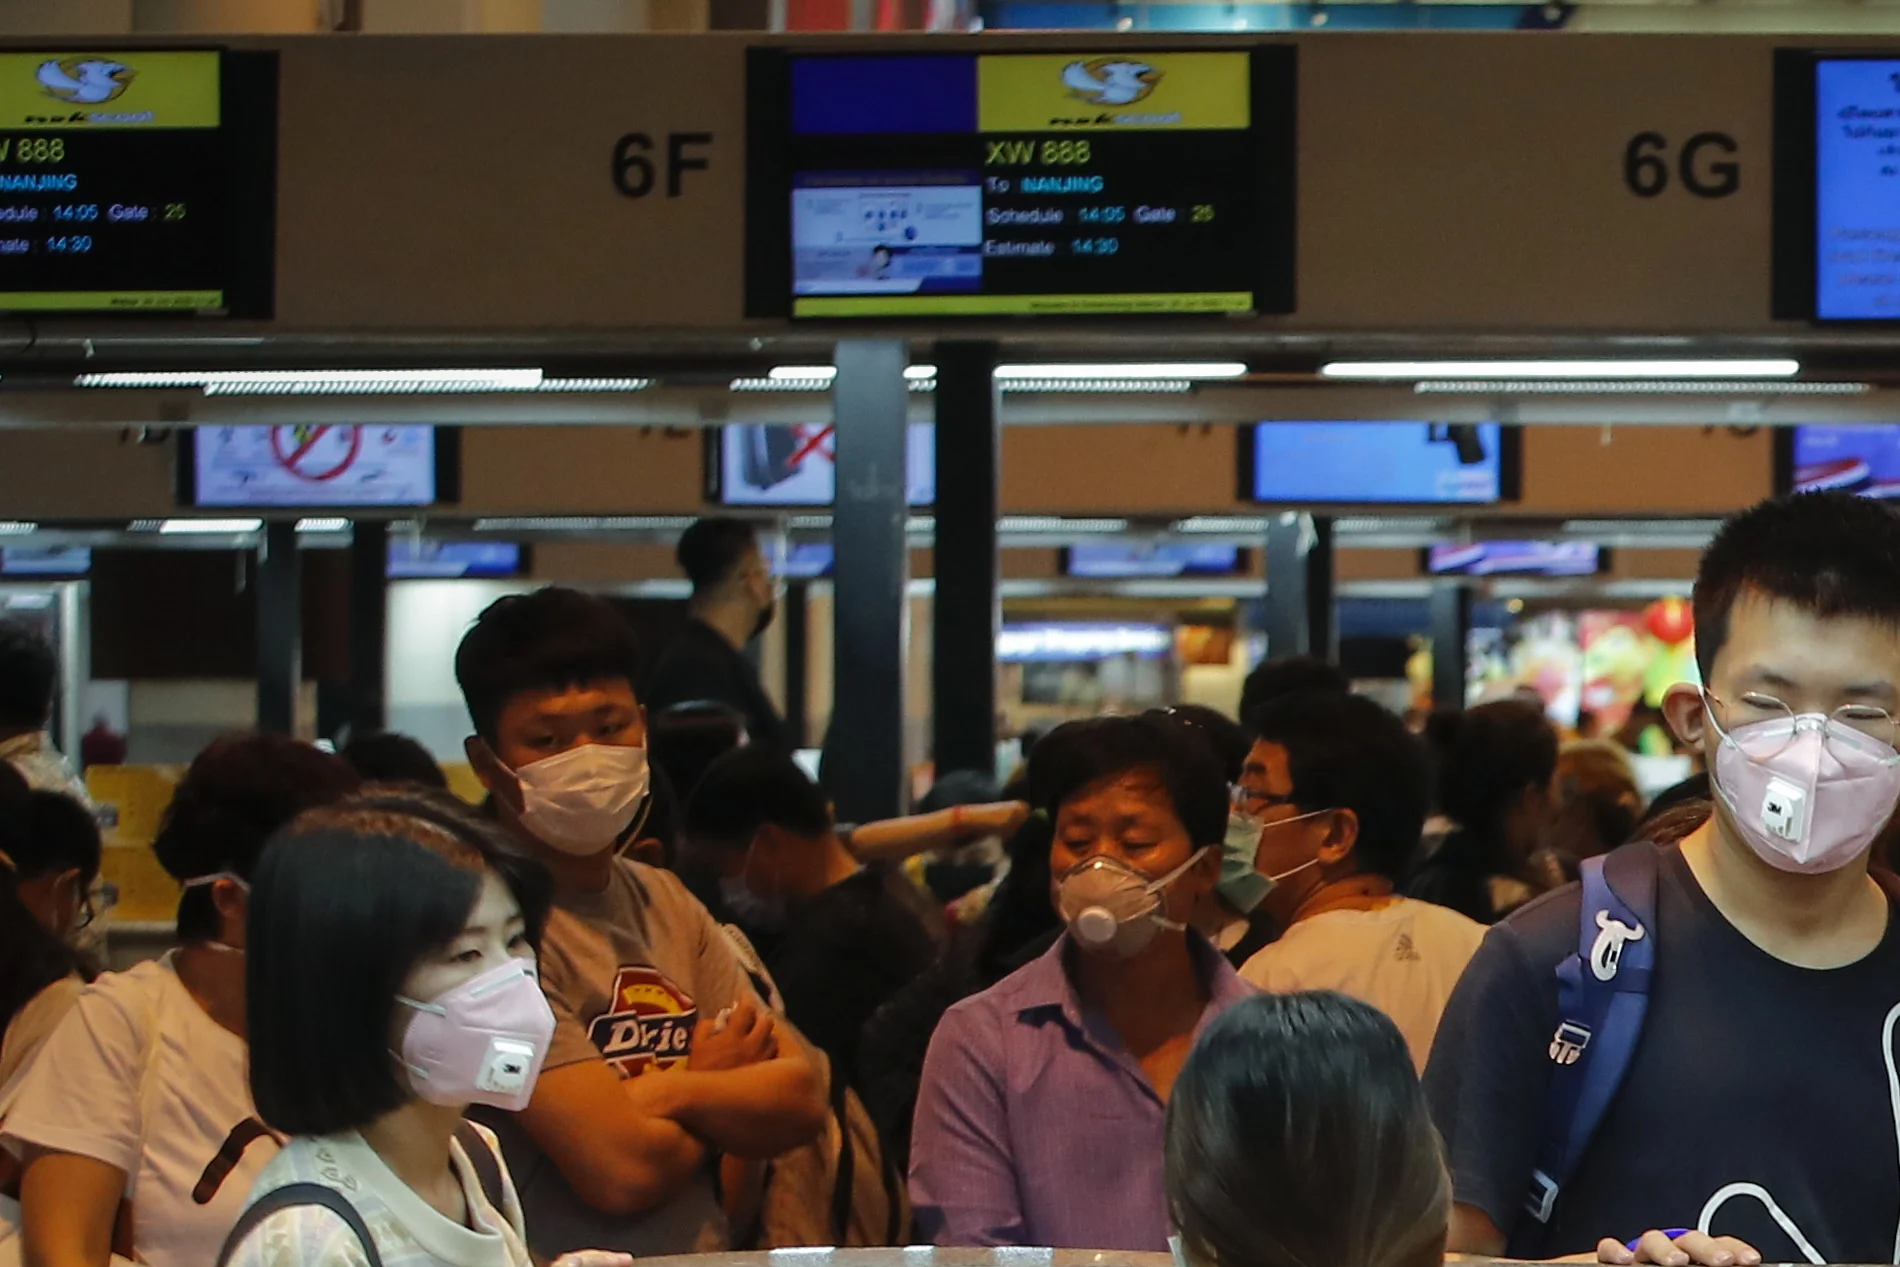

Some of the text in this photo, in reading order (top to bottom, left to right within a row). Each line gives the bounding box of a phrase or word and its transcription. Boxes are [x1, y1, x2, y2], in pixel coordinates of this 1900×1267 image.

[17, 138, 65, 163] 888
[985, 140, 1091, 165] XW 888
[611, 132, 714, 199] 6F
[1625, 131, 1741, 199] 6G
[987, 175, 1104, 193] To NANJING
[53, 204, 98, 221] 14:05
[108, 204, 148, 222] Gate
[986, 206, 1064, 224] Schedule
[1133, 206, 1176, 224] Gate
[985, 240, 1055, 256] Estimate
